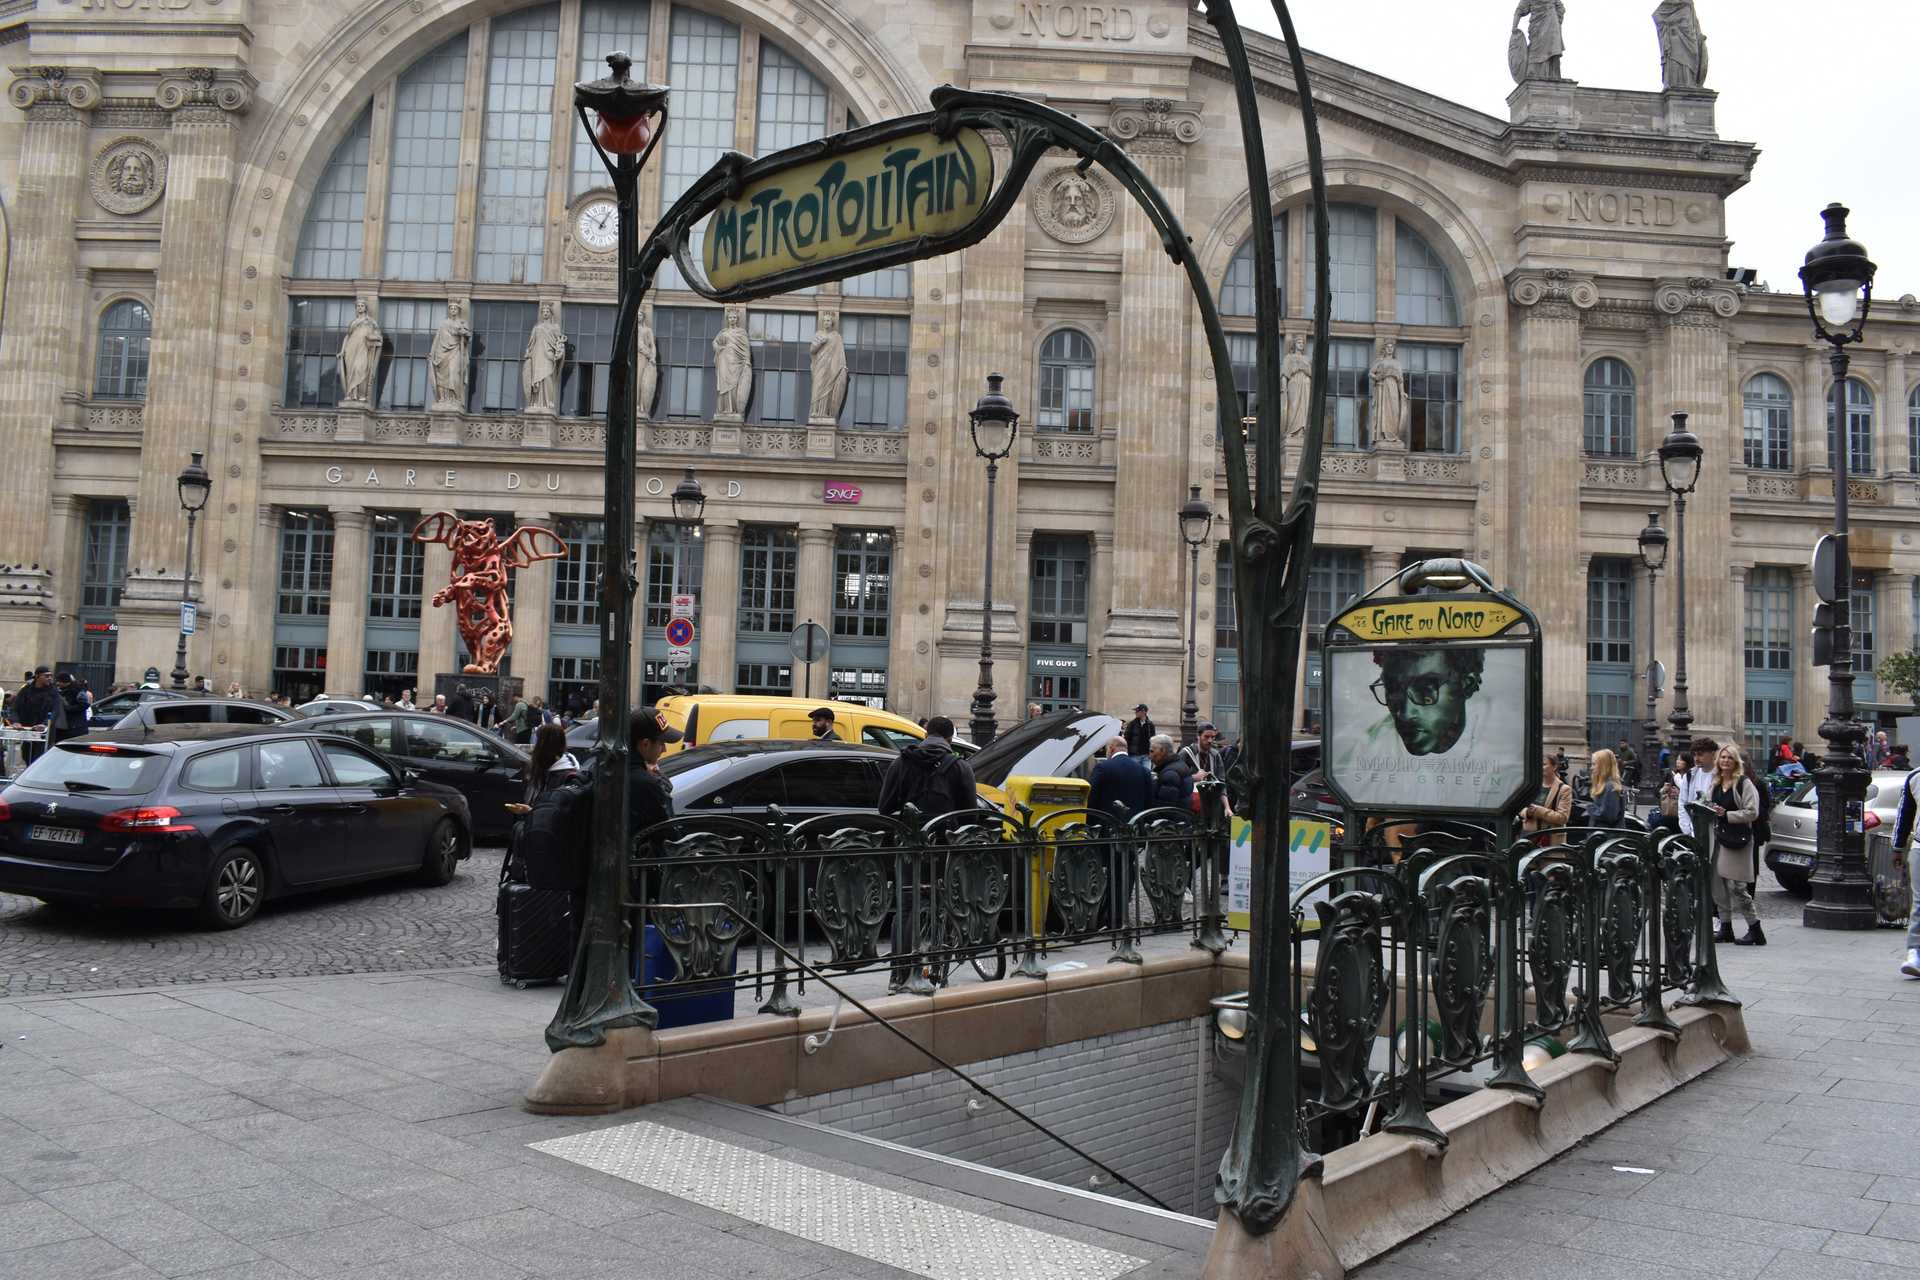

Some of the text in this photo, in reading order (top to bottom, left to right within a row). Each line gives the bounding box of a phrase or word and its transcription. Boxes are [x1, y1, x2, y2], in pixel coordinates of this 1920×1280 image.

[1020, 3, 1137, 41] NORD
[712, 136, 977, 271] METROPOLITAIN
[1567, 189, 1679, 227] NORD
[326, 466, 457, 488] GARE
[507, 472, 561, 490] DU
[825, 488, 861, 500] SNCF
[1354, 773, 1502, 786] SEE GREEN
